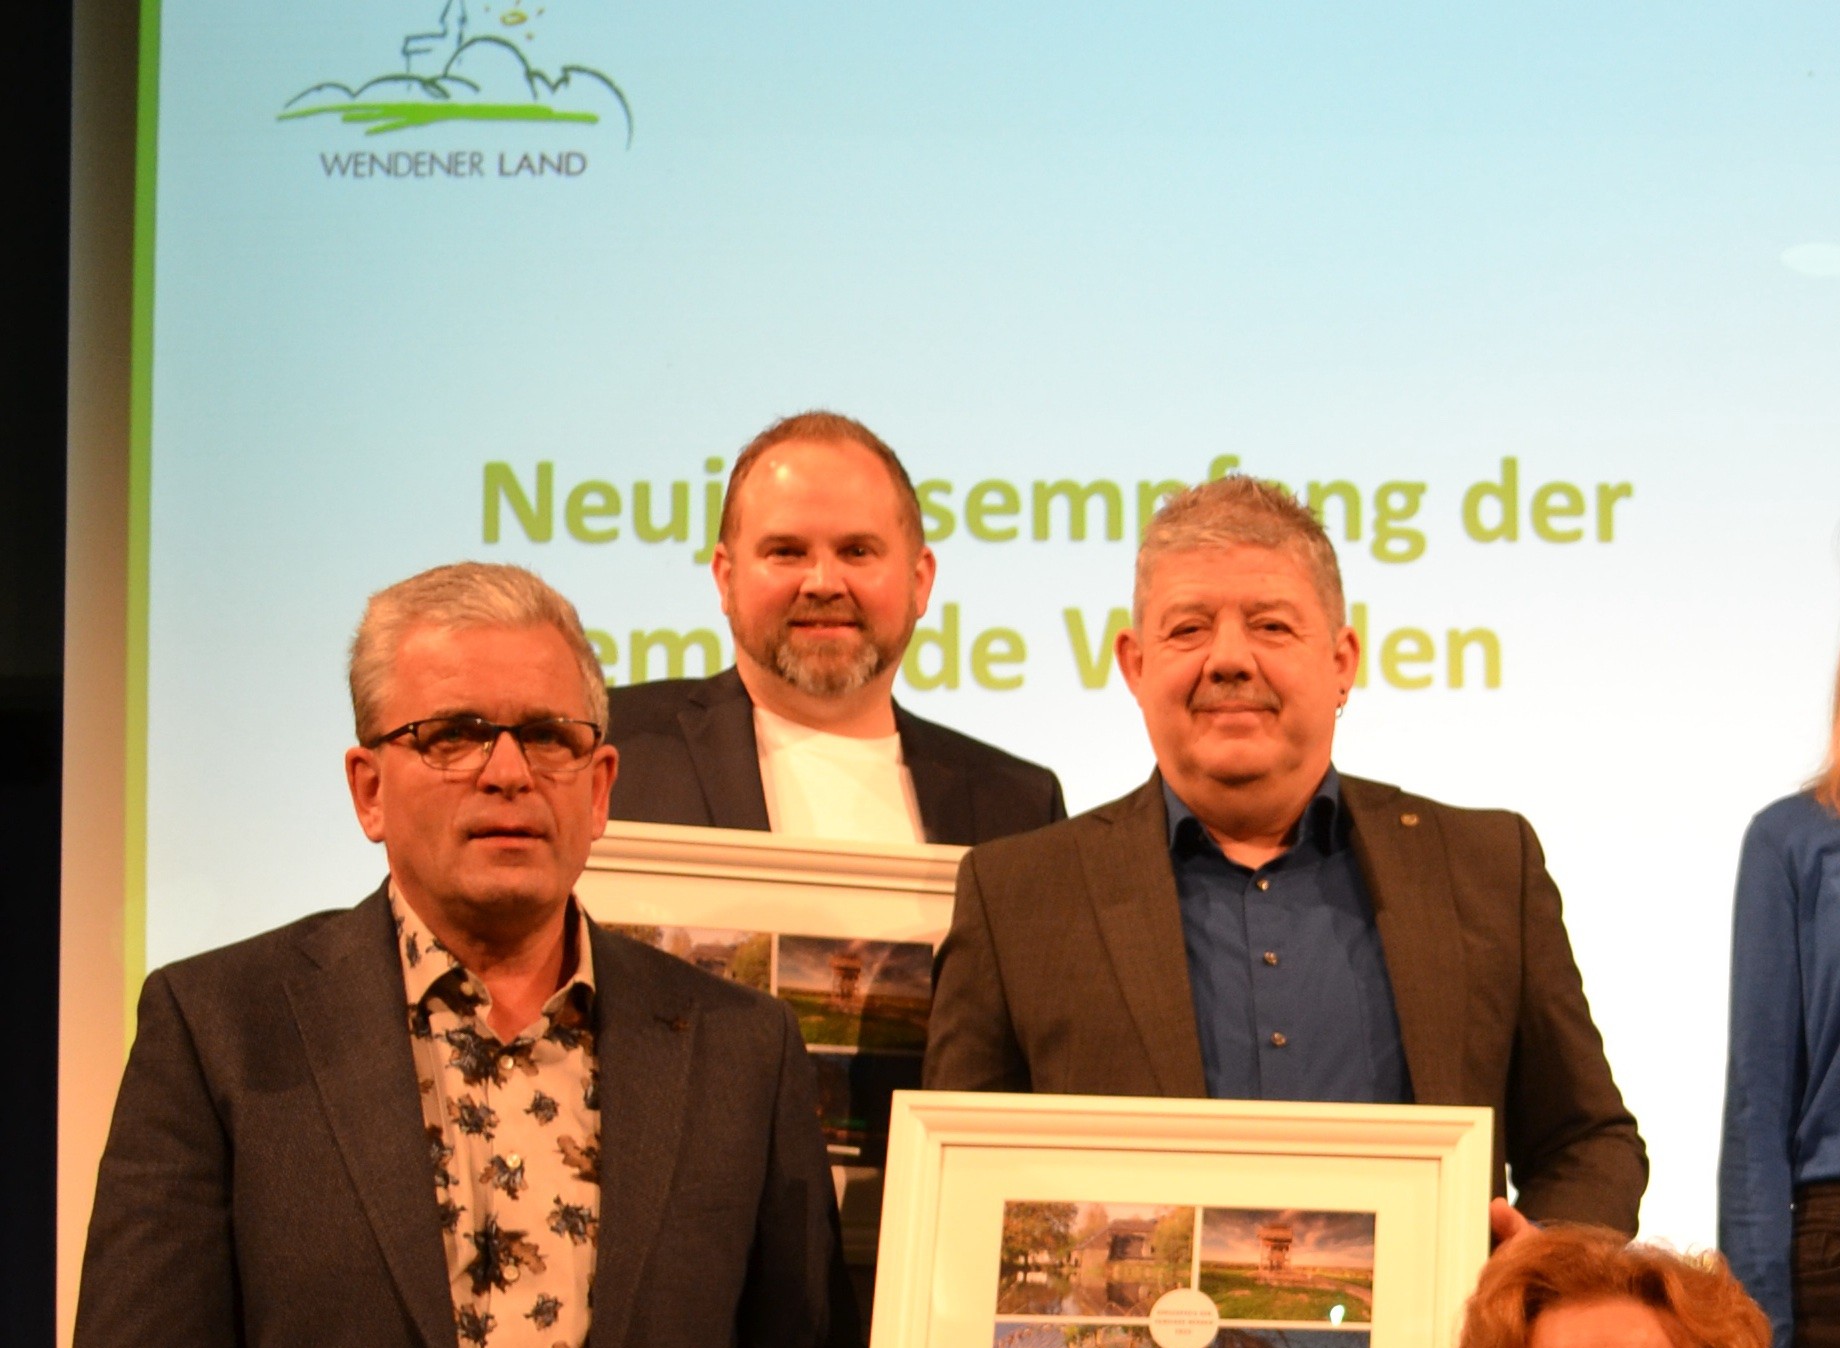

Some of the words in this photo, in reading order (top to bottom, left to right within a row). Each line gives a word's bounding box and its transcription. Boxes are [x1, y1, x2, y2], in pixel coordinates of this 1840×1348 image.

[319, 151, 484, 177] WENDENER
[498, 151, 588, 177] LAND
[1462, 456, 1633, 543] der
